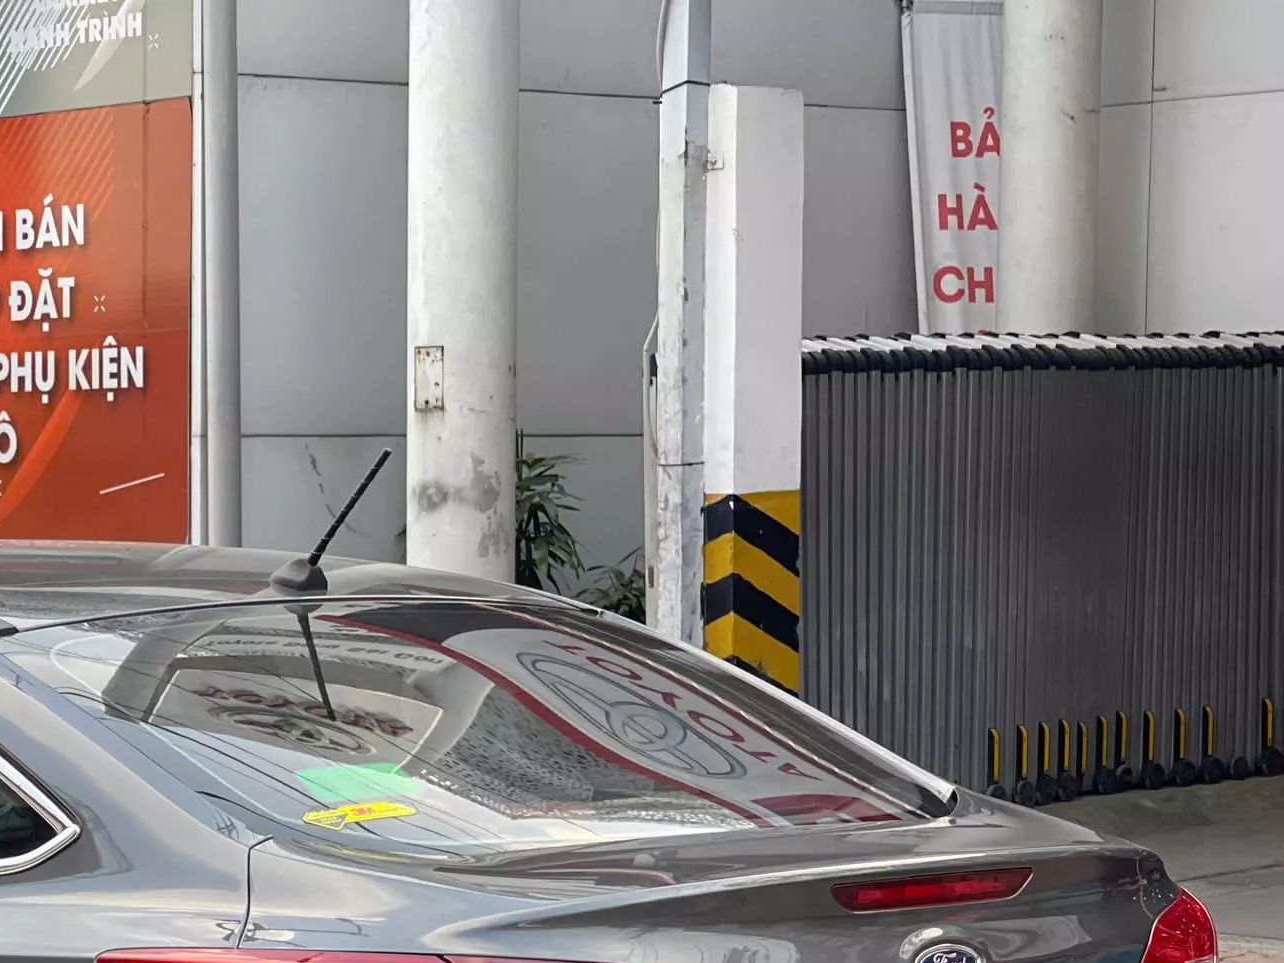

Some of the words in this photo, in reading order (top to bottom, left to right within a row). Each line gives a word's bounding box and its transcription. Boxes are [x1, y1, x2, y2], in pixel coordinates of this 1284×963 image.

[76, 10, 142, 43] TRÌNH
[16, 193, 84, 250] BÁN
[937, 181, 998, 231] HÀ
[8, 268, 75, 332] ĐẶT
[933, 266, 995, 303] CH
[68, 335, 144, 401] KIỆN
